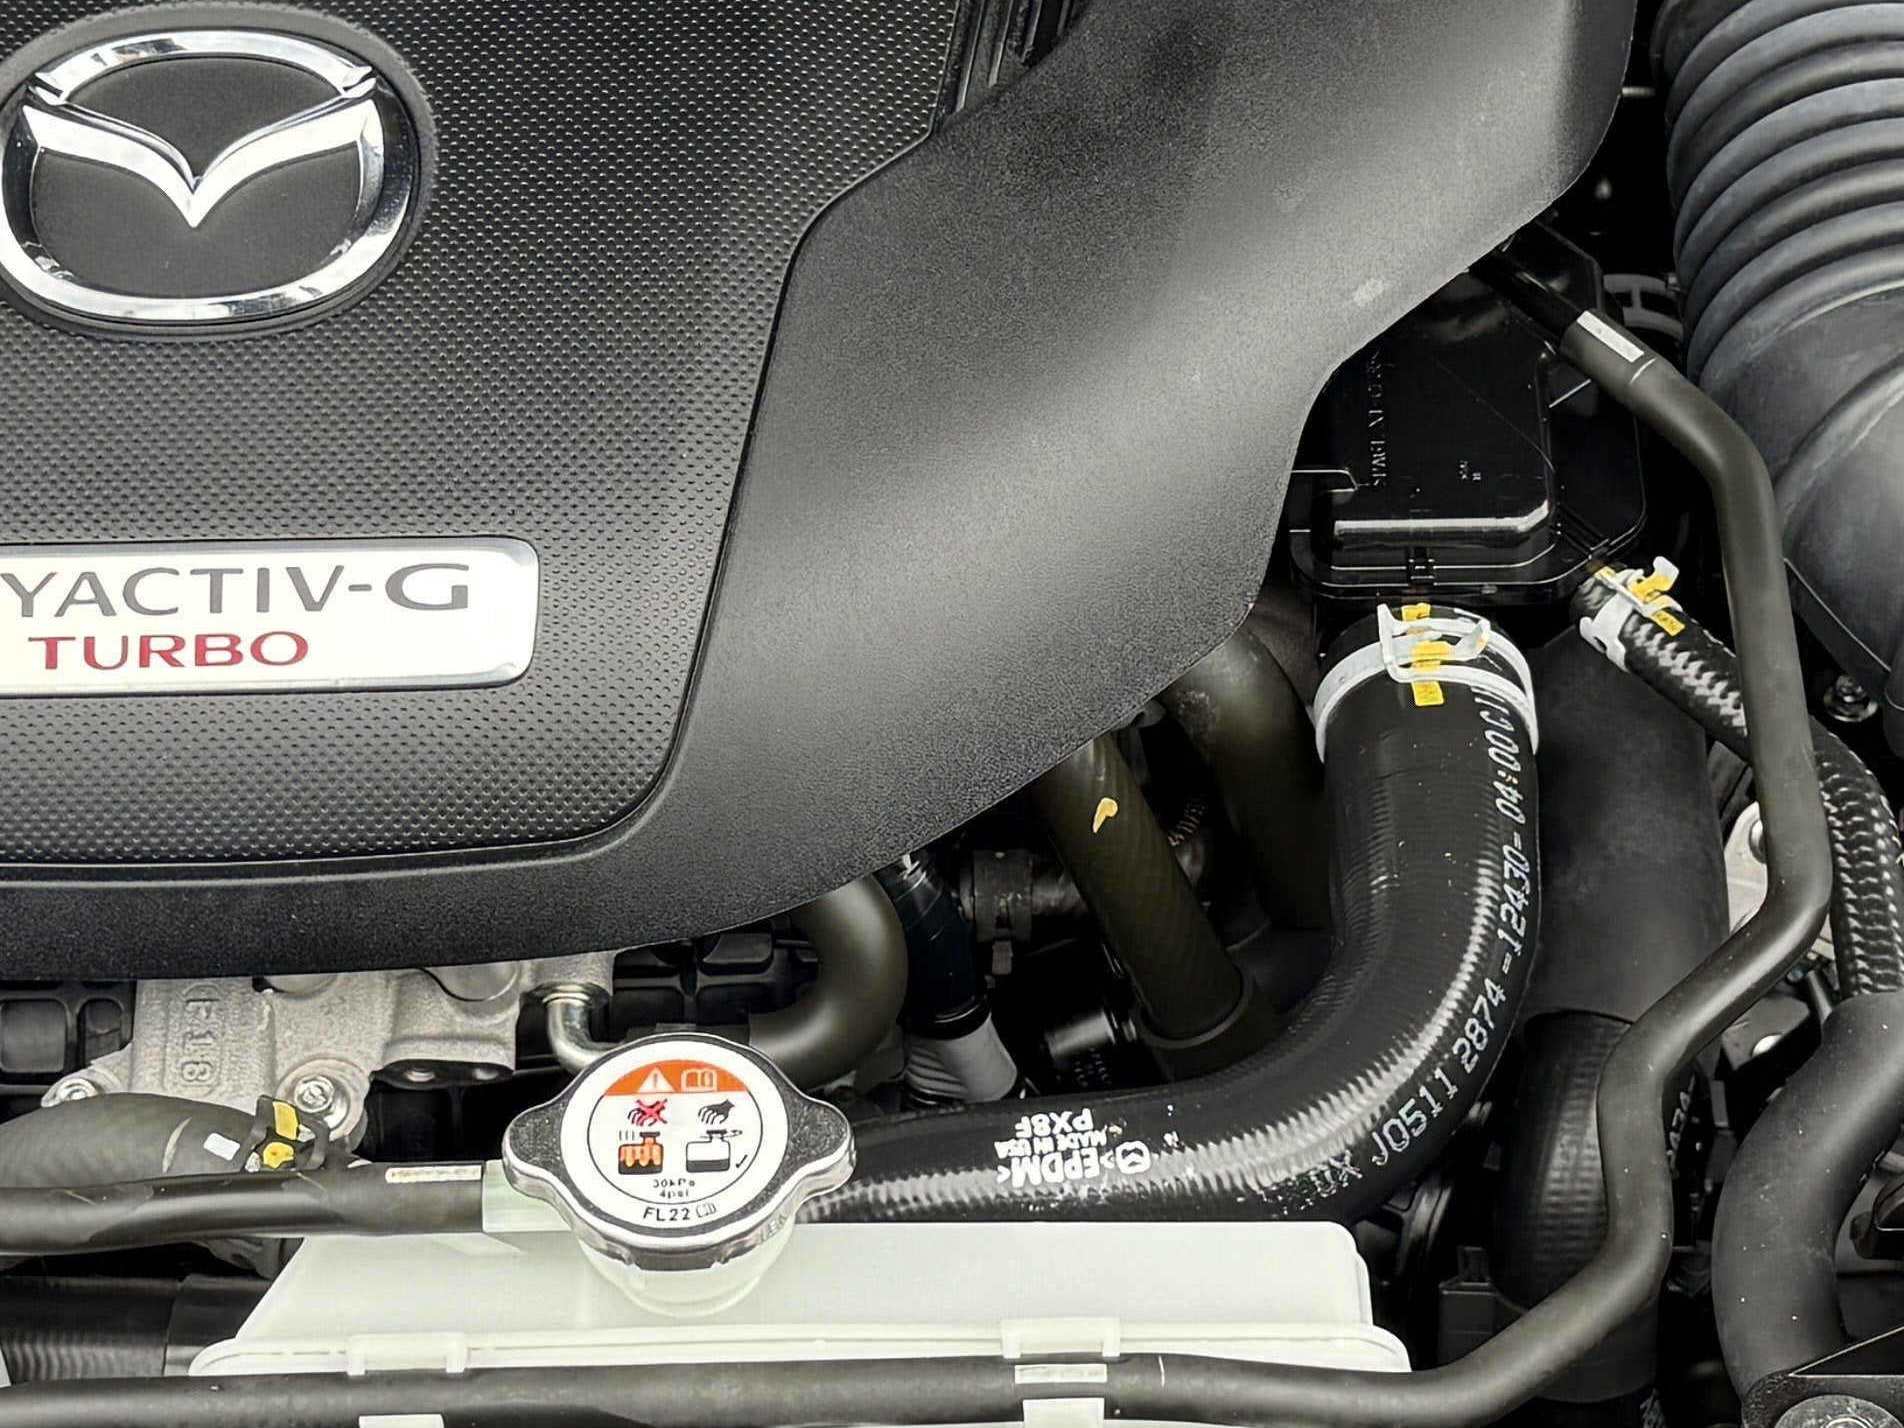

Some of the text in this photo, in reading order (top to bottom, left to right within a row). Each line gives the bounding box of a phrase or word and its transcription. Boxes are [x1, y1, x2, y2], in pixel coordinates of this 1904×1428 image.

[28, 630, 310, 671] TURBO
[1452, 978, 1507, 1074] 2874
[1015, 1107, 1094, 1138] PX8F
[994, 1125, 1107, 1159] MADE IN USA
[643, 1206, 691, 1222] FL22
